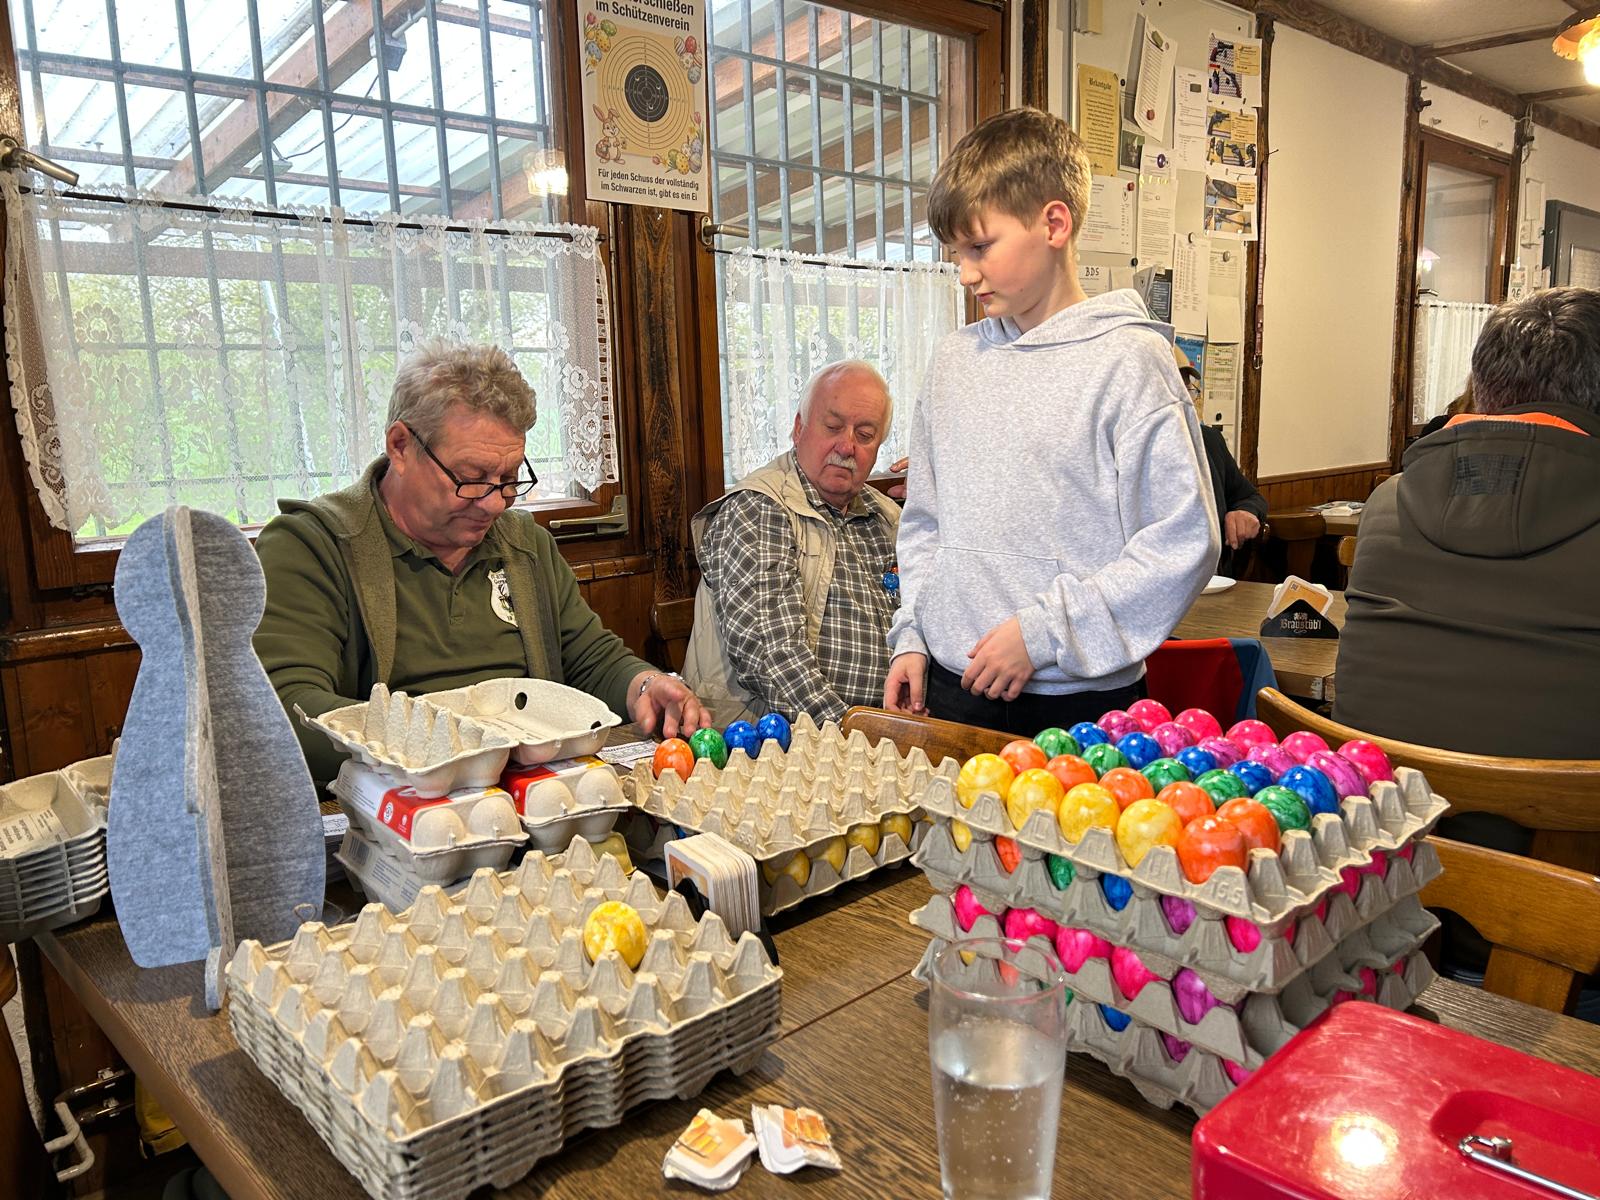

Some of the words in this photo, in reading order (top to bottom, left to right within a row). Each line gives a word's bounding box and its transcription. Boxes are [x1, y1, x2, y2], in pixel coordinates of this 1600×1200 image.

[612, 1, 690, 31] Schützenverein
[598, 168, 609, 178] Für
[610, 170, 629, 180] jeden
[630, 173, 653, 184] Schuss
[655, 176, 665, 184] der
[666, 178, 699, 191] vollständig
[601, 181, 610, 190] im
[611, 183, 647, 195] Schwarzen
[648, 187, 658, 197] ist,
[659, 189, 671, 199] gibt
[681, 193, 690, 201] ein
[692, 193, 698, 201] Ei
